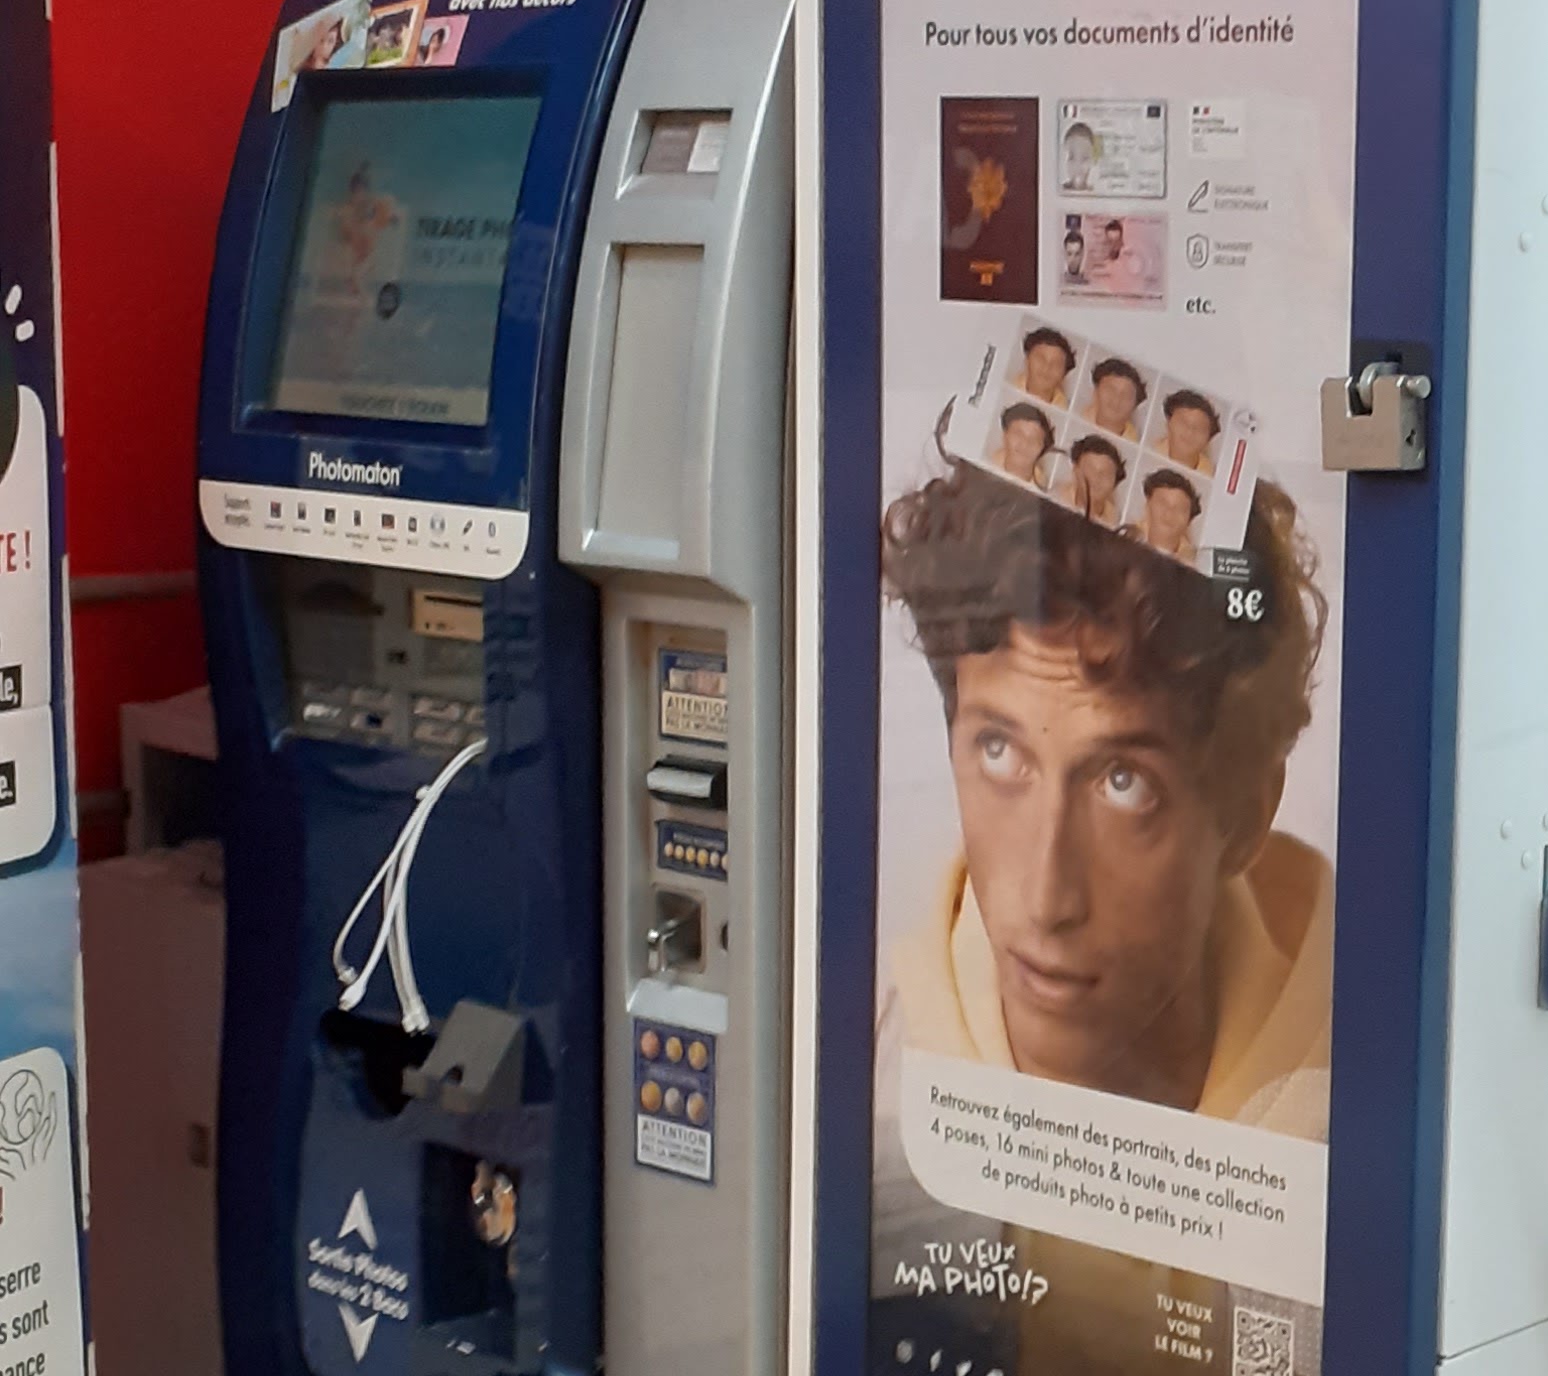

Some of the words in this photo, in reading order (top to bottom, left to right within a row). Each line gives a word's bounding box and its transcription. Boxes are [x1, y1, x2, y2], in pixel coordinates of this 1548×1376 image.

[924, 21, 969, 47] Pour
[975, 23, 1018, 46] tous
[1024, 27, 1058, 46] vos
[1064, 17, 1180, 46] documents
[1186, 15, 1295, 44] d'identité
[1185, 296, 1217, 315] etc.
[1227, 587, 1265, 622] 8€
[930, 1085, 999, 1121] Retrouvez
[1003, 1104, 1079, 1140] également
[1082, 1122, 1109, 1148] des
[1112, 1134, 1180, 1169] portraits,
[1184, 1147, 1212, 1173] des
[1215, 1155, 1287, 1191] planches
[930, 1117, 940, 1135] 4
[944, 1125, 990, 1152] poses,
[997, 1132, 1014, 1155] 16
[1018, 1140, 1049, 1164] mini
[1052, 1147, 1105, 1179] photos
[1108, 1160, 1122, 1181] &
[1126, 1167, 1167, 1194] toute
[1171, 1182, 1201, 1202] une
[1205, 1187, 1286, 1224] collection
[981, 1158, 1001, 1182] de
[1004, 1170, 1066, 1200] produits
[1069, 1181, 1115, 1212] photo
[1119, 1194, 1130, 1216] à
[1134, 1202, 1177, 1229] petits
[1180, 1215, 1214, 1240] prix
[923, 1241, 953, 1265] TU
[958, 1237, 1016, 1269] VEUX
[894, 1260, 938, 1298] MA
[12, 1299, 50, 1340] sont
[1156, 1293, 1174, 1312] TU
[1175, 1299, 1213, 1324] VEUX
[1166, 1317, 1201, 1340] VOIR
[1154, 1333, 1169, 1353] LE
[1170, 1338, 1202, 1361] FILM
